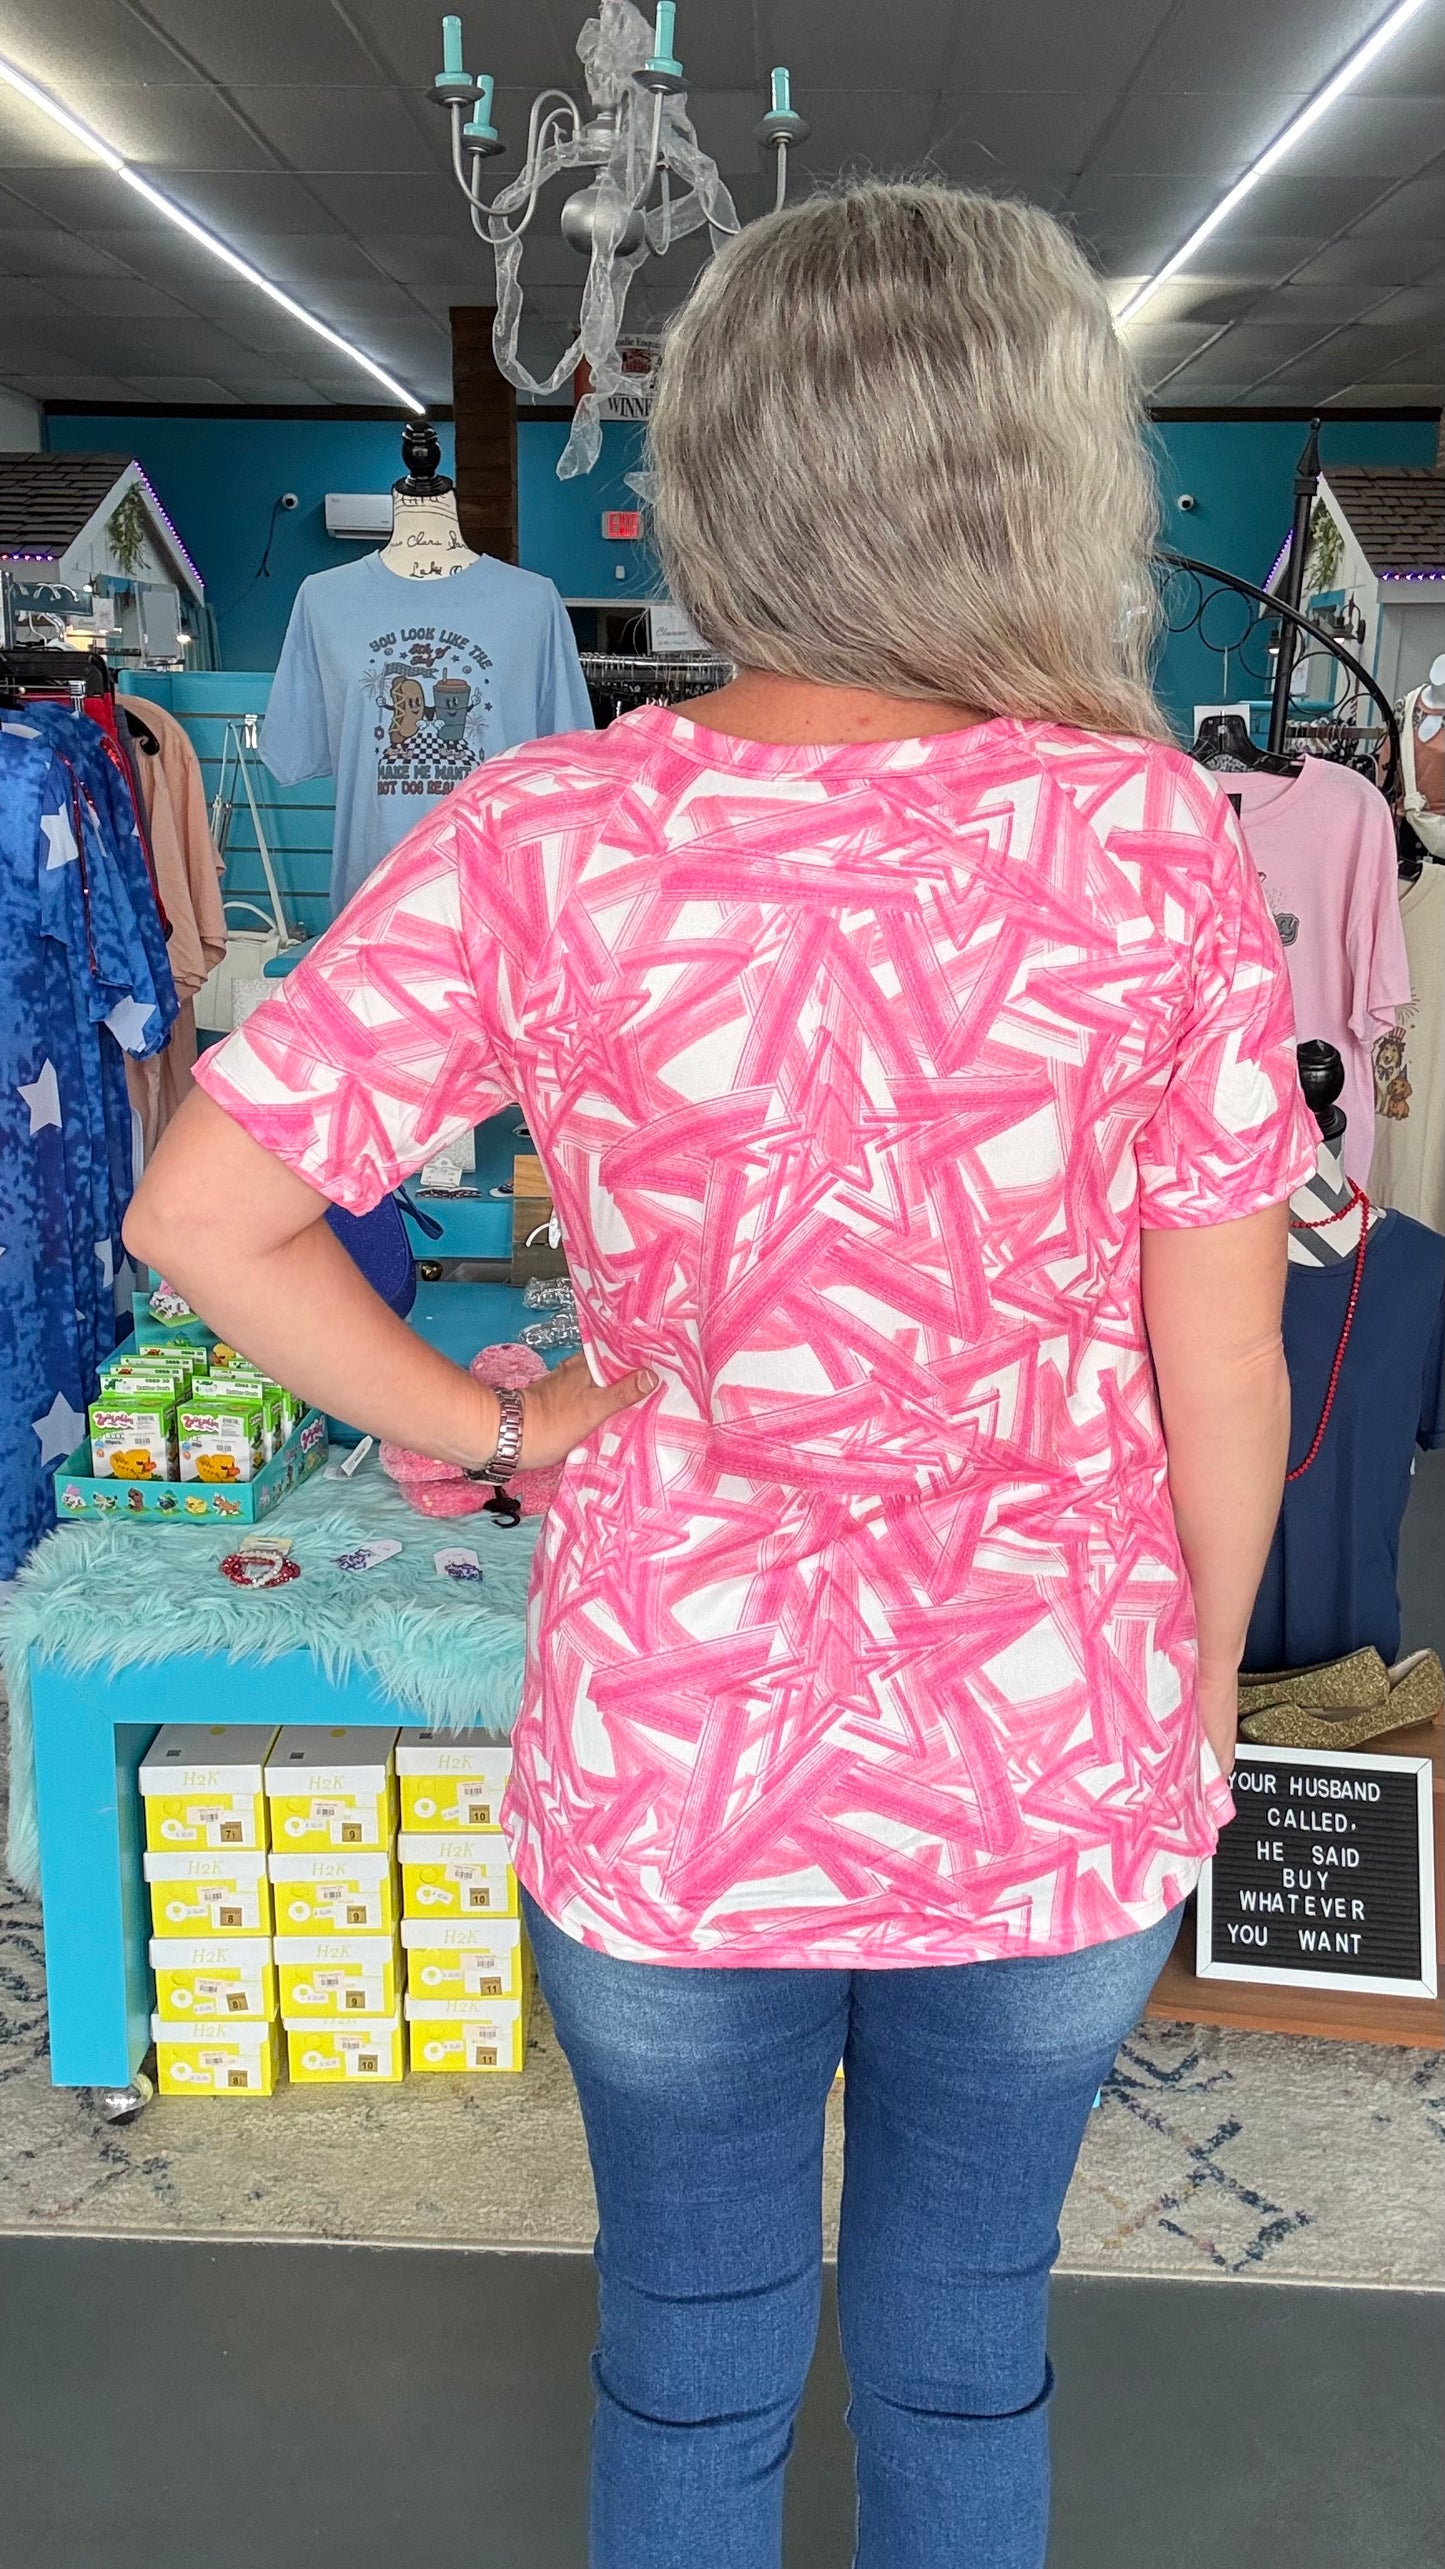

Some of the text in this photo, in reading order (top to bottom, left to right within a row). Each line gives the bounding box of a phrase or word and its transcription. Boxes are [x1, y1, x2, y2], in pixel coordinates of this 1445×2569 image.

[369, 627, 494, 670] YOU LOOK LIKE THE
[413, 765, 431, 780] ME
[435, 765, 472, 780] WANT
[401, 780, 424, 795] DOG
[438, 1754, 473, 1769] H2K
[182, 1771, 220, 1786] H2K
[309, 1775, 345, 1790] H2K
[1228, 1771, 1381, 1802] YOUR HUSBAND
[474, 1812, 486, 1821] 10
[1267, 1807, 1357, 1833] CALLED,
[439, 1842, 475, 1857] H2K
[1256, 1840, 1360, 1868] HE SAID
[188, 1860, 224, 1875] H2K
[312, 1862, 348, 1876] H2K
[1282, 1868, 1329, 1891] BUY
[473, 1895, 486, 1904] 10
[1239, 1890, 1365, 1921] WHATEVER
[444, 1929, 480, 1944] H2K
[1227, 1923, 1362, 1955] YOU WANT
[192, 1947, 230, 1964] H2K
[316, 1944, 352, 1959] H2K
[486, 1985, 497, 1994] 11
[193, 2023, 227, 2038] H2K
[361, 2061, 374, 2070] 10
[482, 2056, 493, 2065] 11
